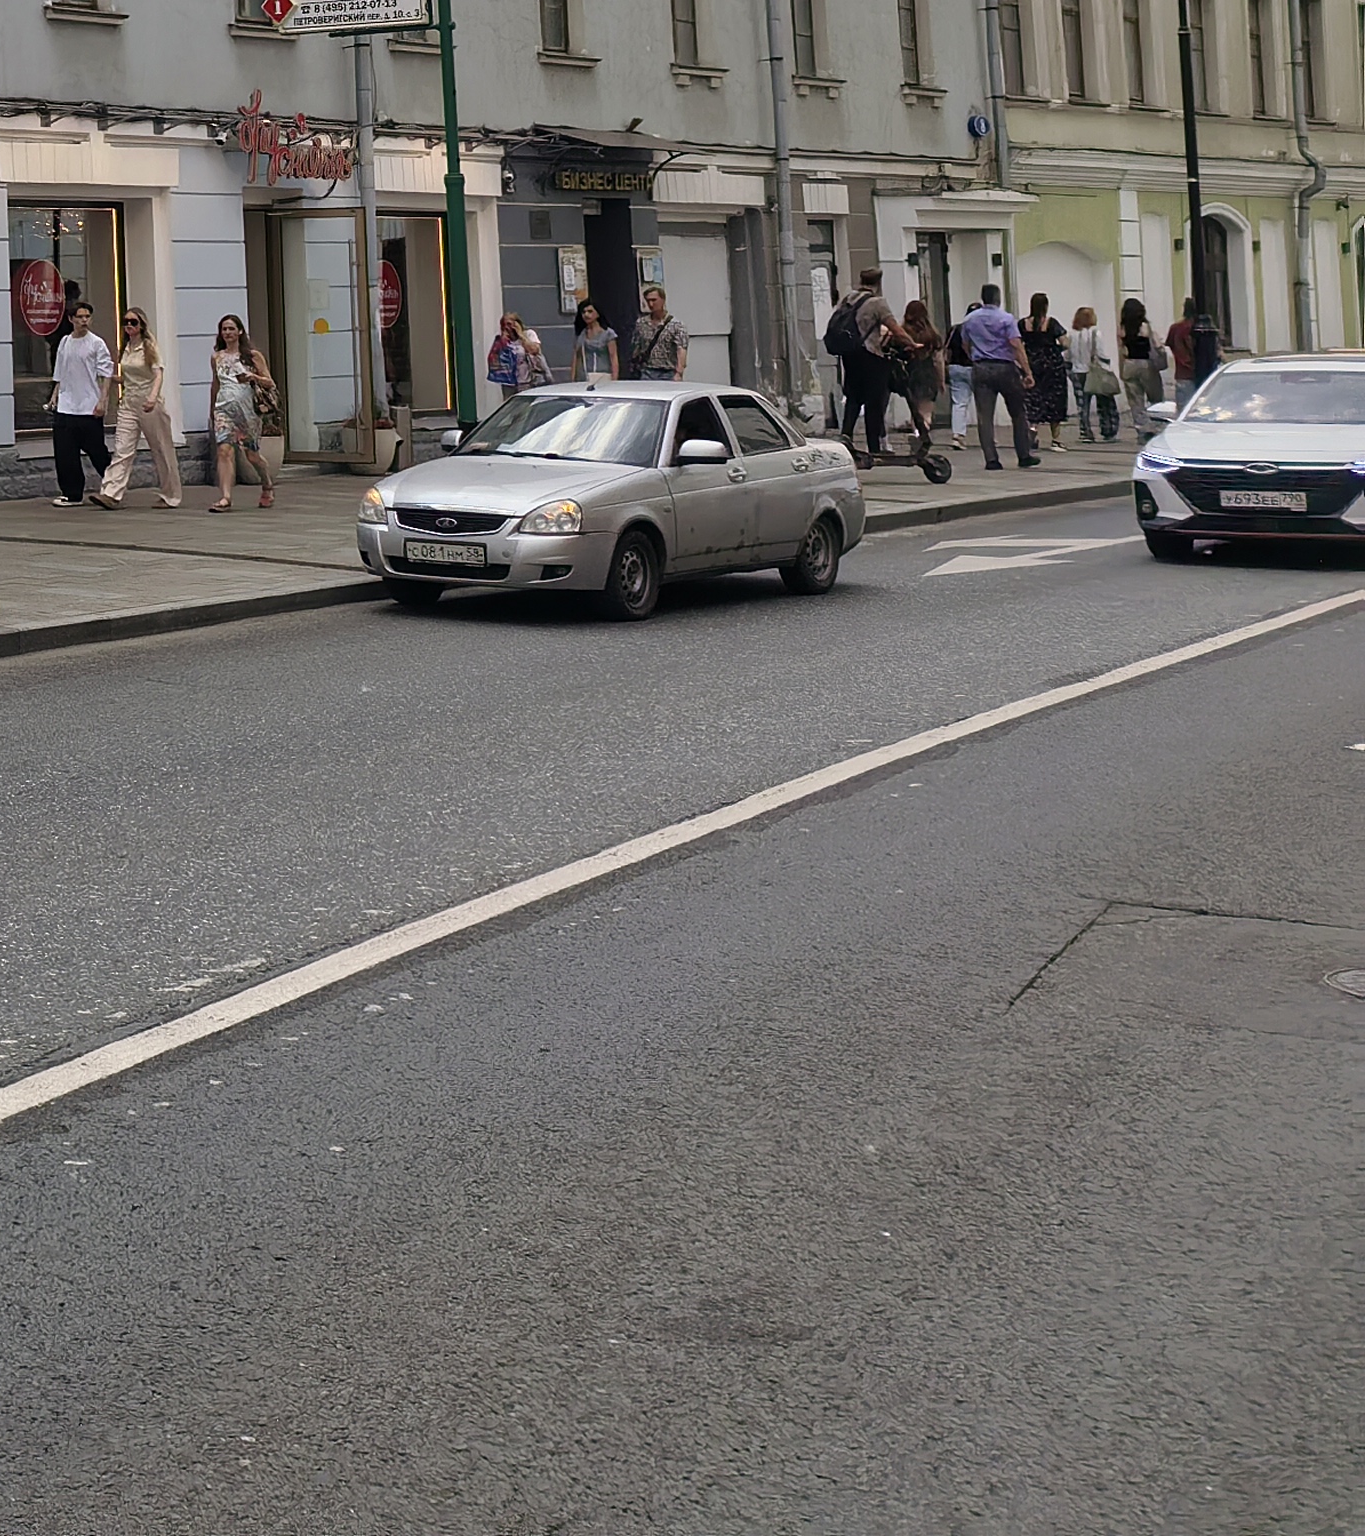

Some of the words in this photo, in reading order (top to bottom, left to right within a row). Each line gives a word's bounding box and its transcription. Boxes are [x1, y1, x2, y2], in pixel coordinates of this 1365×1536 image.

[314, 4, 320, 14] 8
[322, 2, 347, 15] (495)
[293, 10, 366, 26] ПЕТРОВЕРИГСКИЙ
[562, 170, 613, 191] БИЗНЕС
